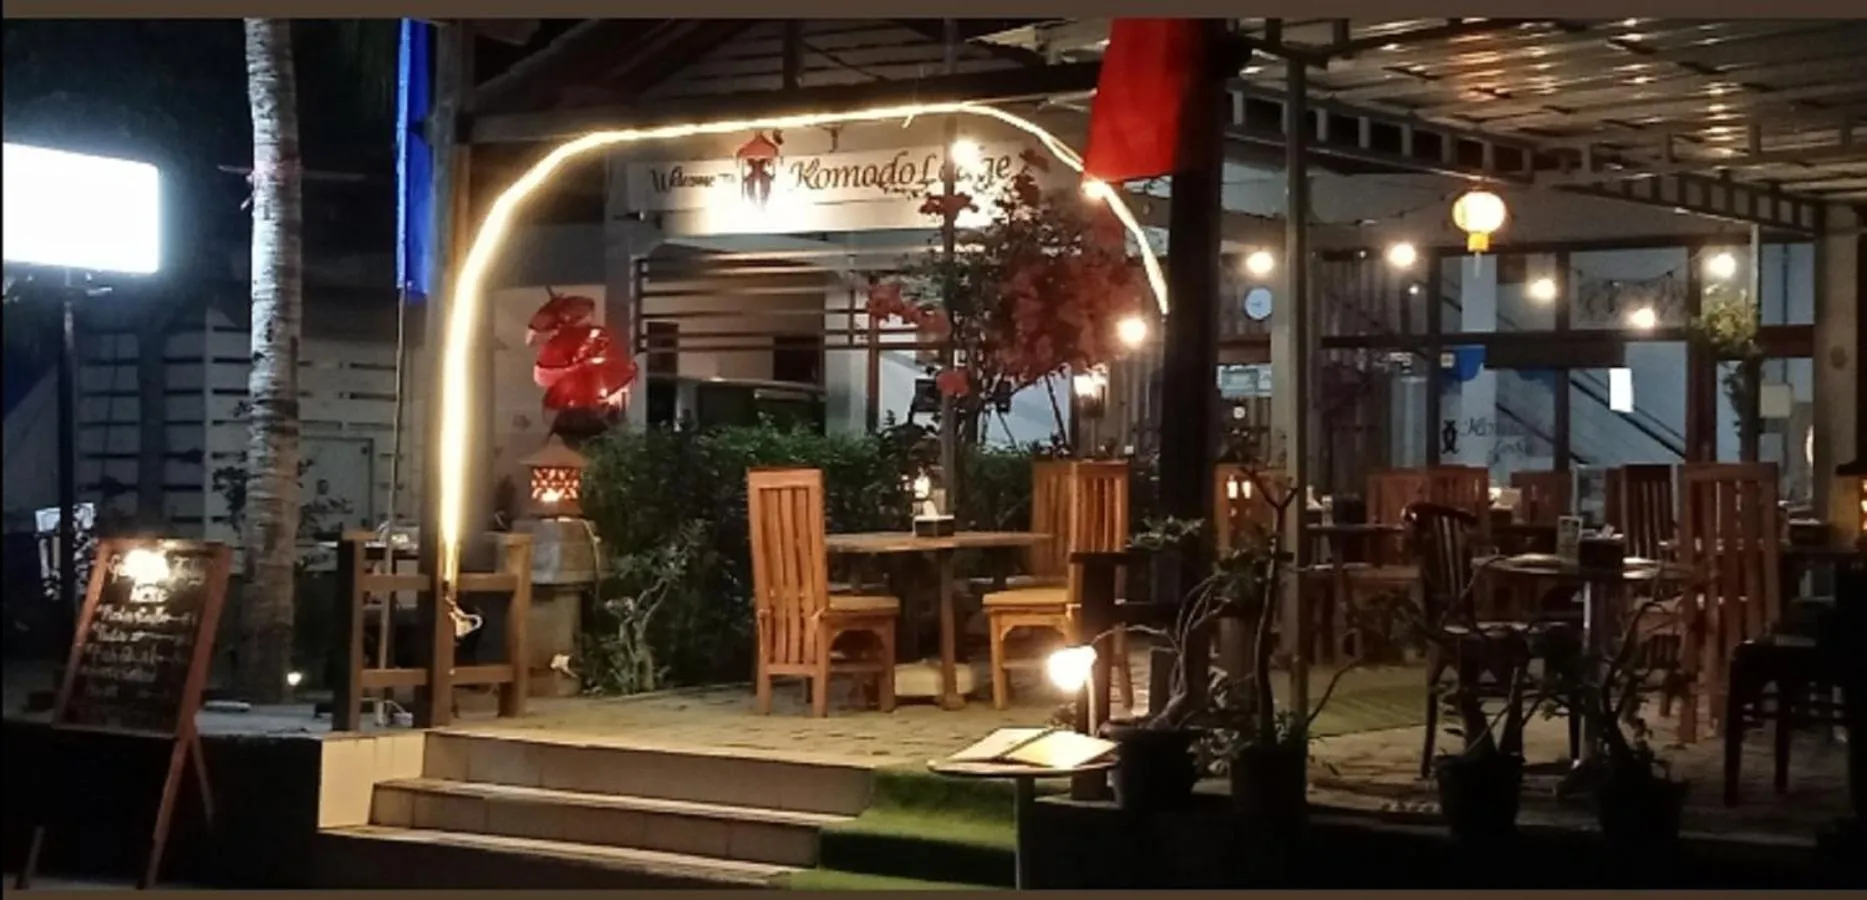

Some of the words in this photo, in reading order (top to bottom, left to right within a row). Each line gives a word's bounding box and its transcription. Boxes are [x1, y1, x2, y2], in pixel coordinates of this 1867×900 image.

[651, 165, 716, 193] Welcome
[789, 150, 916, 190] Komodo
[914, 152, 1011, 193] Lge
